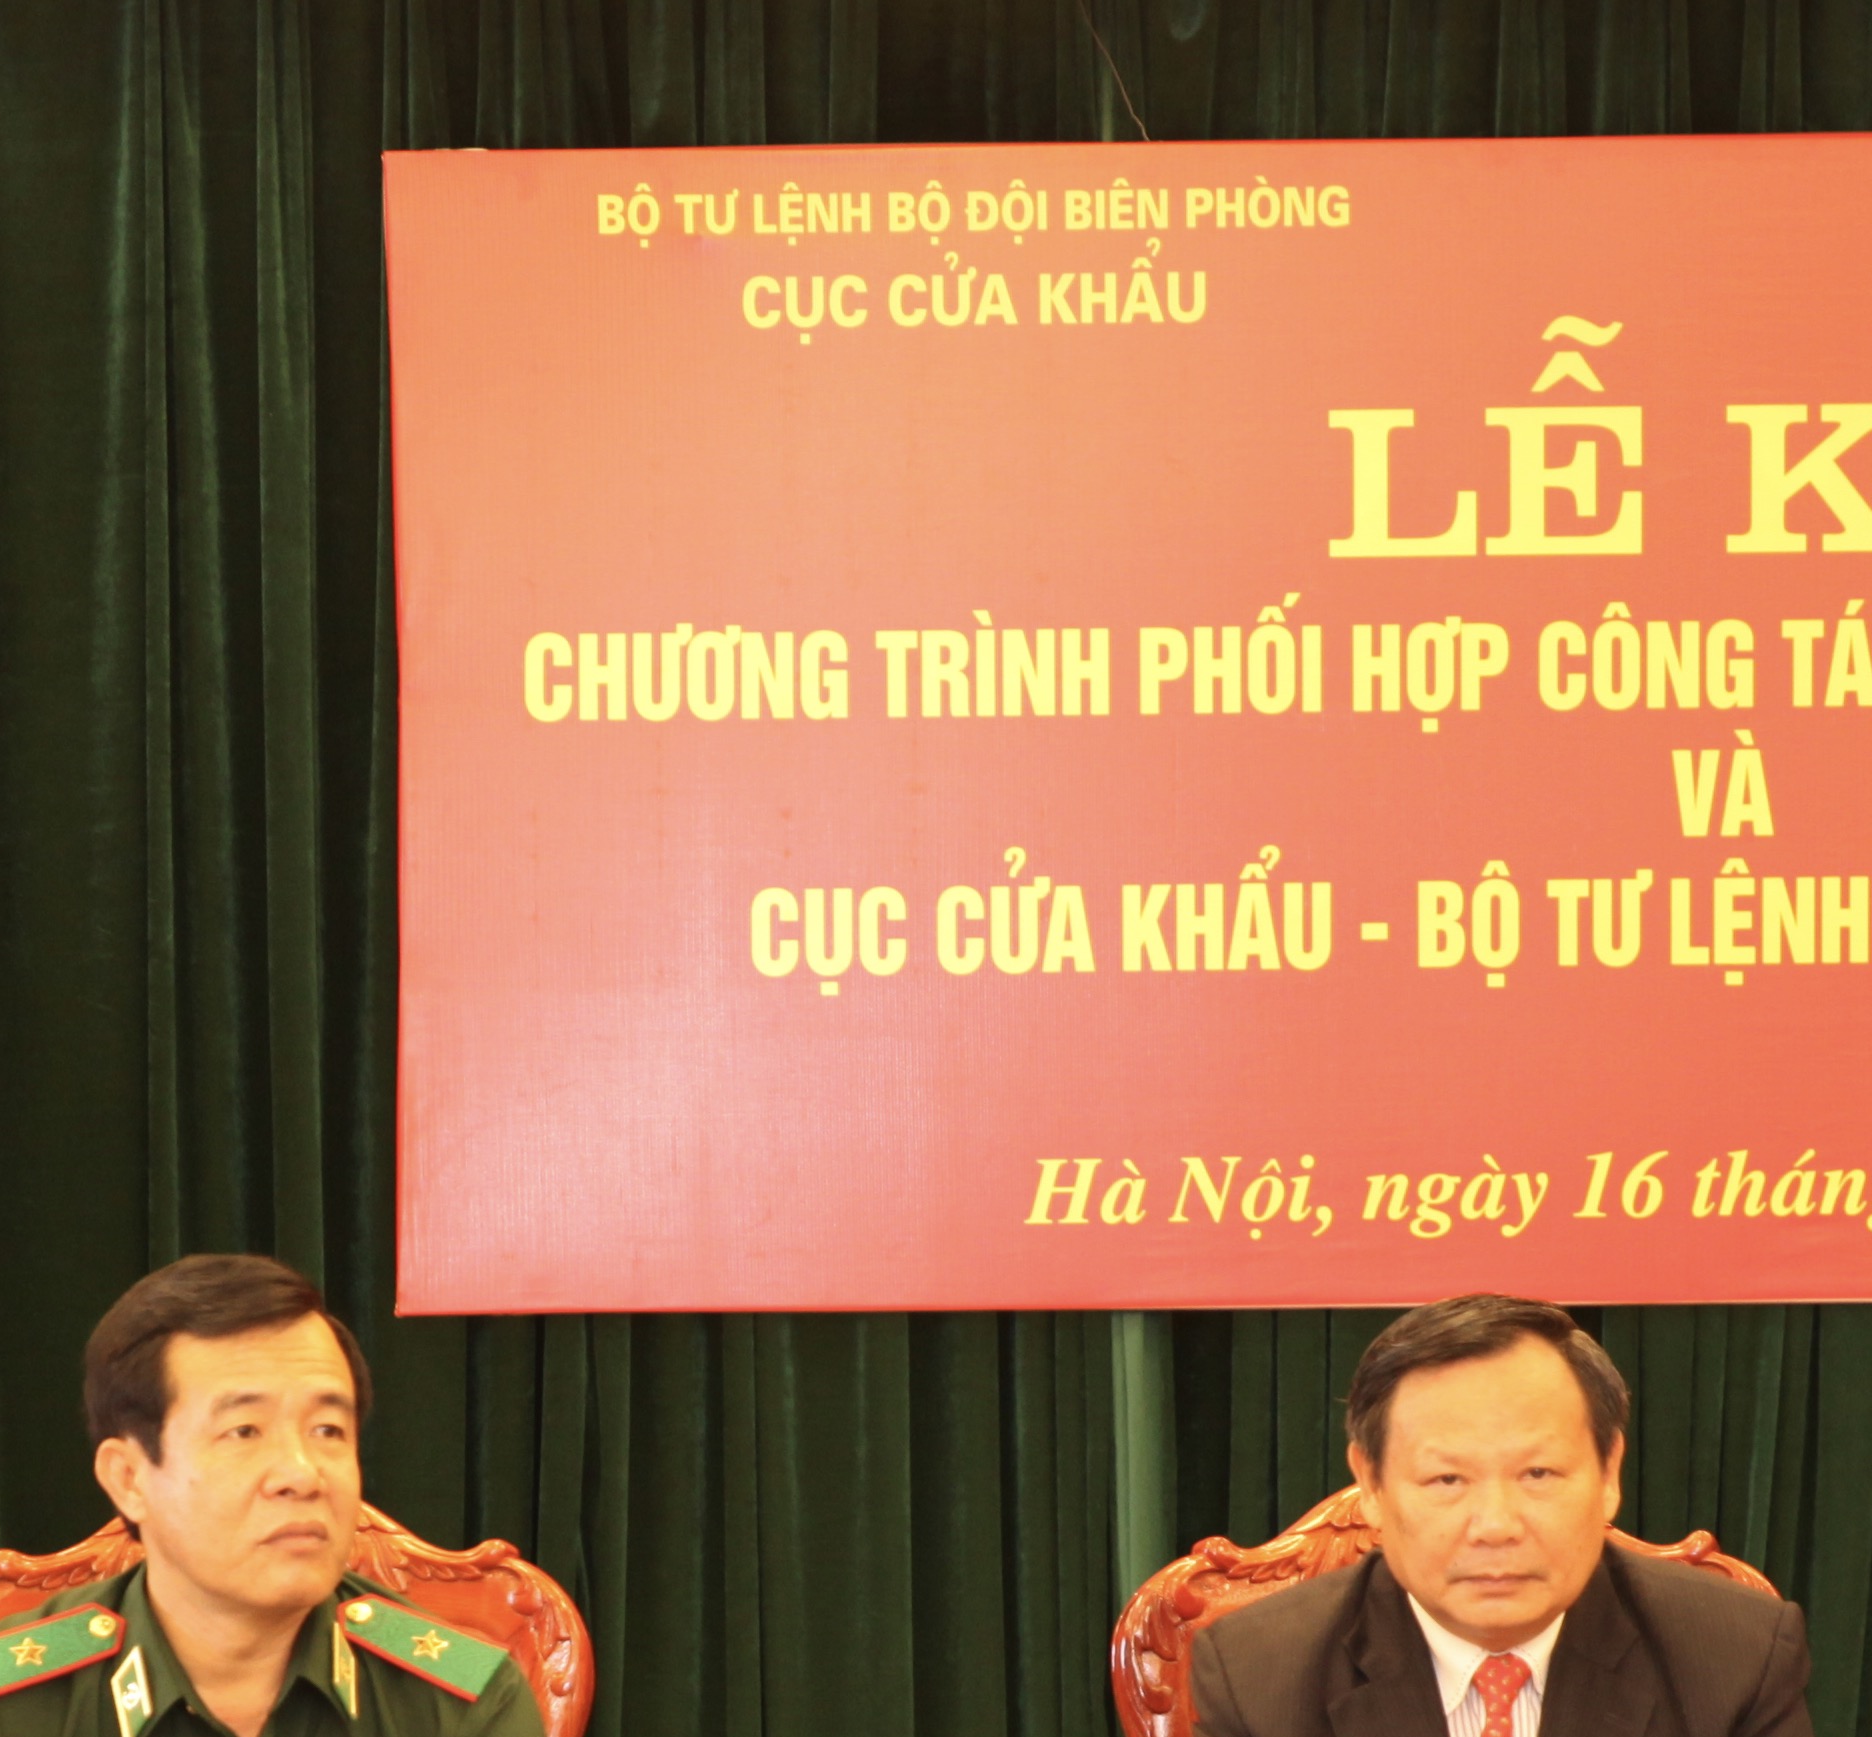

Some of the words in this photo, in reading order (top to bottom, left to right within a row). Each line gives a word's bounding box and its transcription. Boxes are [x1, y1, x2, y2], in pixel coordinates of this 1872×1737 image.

[599, 184, 661, 249] BỘ
[675, 190, 740, 236] TƯ
[755, 183, 872, 247] LỆNH
[889, 181, 951, 246] BỘ
[966, 180, 1048, 245] ĐỘI
[1066, 179, 1169, 231] BIÊN
[1187, 177, 1350, 229] PHÒNG
[742, 276, 868, 345] CỤC
[889, 252, 1018, 328] CỬA
[1039, 238, 1207, 325] KHẨU
[1329, 315, 1643, 559] LỄ
[525, 623, 850, 724] CHƯƠNG
[876, 610, 1111, 719] TRÌNH
[1139, 593, 1323, 716] PHỐI
[1353, 617, 1510, 734] HỢP
[1540, 603, 1755, 712] CÔNG
[1673, 731, 1775, 838] VÀ
[751, 887, 908, 997] CỤC
[937, 847, 1097, 976] CỬA
[1123, 845, 1332, 973] KHẨU
[1362, 924, 1389, 941] -
[1418, 861, 1521, 988] BỘ
[1548, 870, 1654, 968] TƯ
[1671, 859, 1870, 986] LỆNH
[1025, 1159, 1147, 1225] Hà
[1170, 1156, 1333, 1240] Nội,
[1364, 1155, 1549, 1239] ngày
[1575, 1152, 1669, 1219] 16
